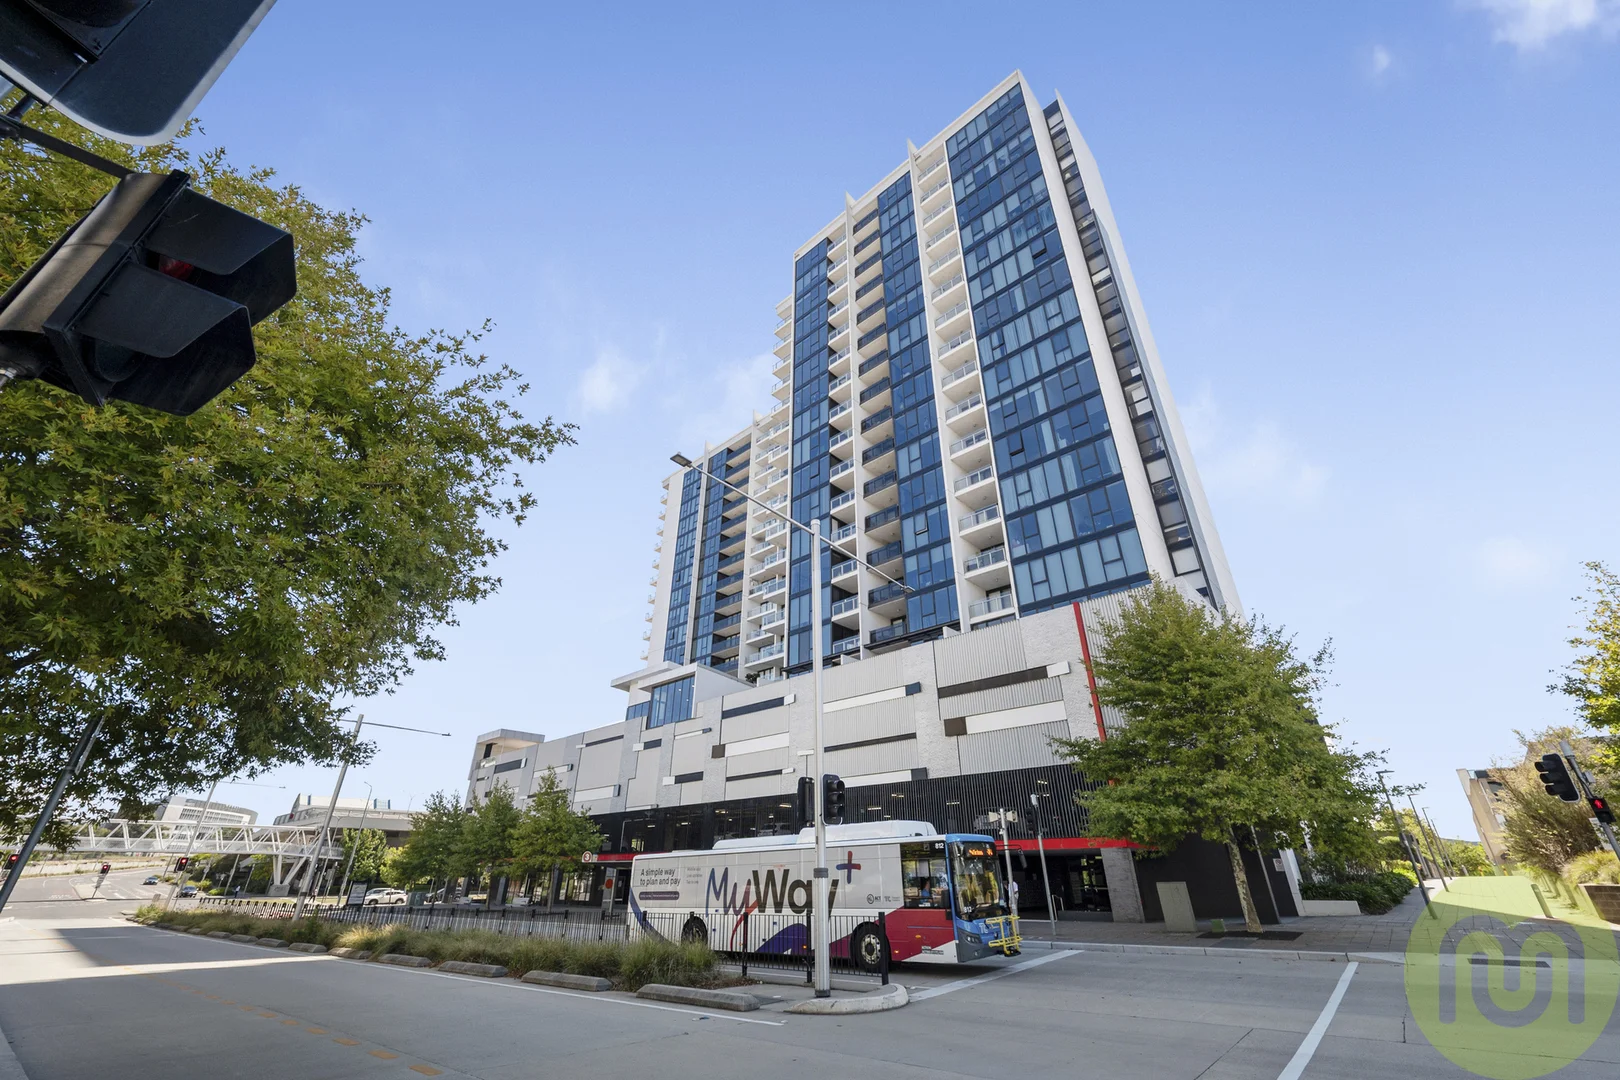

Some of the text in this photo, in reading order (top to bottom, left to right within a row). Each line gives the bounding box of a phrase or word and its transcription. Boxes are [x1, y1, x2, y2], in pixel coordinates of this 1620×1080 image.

[584, 853, 590, 861] 3
[640, 868, 645, 876] A
[645, 868, 663, 877] simple
[664, 868, 676, 877] way
[640, 878, 646, 886] to
[645, 877, 658, 887] plan
[658, 877, 670, 885] and
[670, 878, 681, 887] pay
